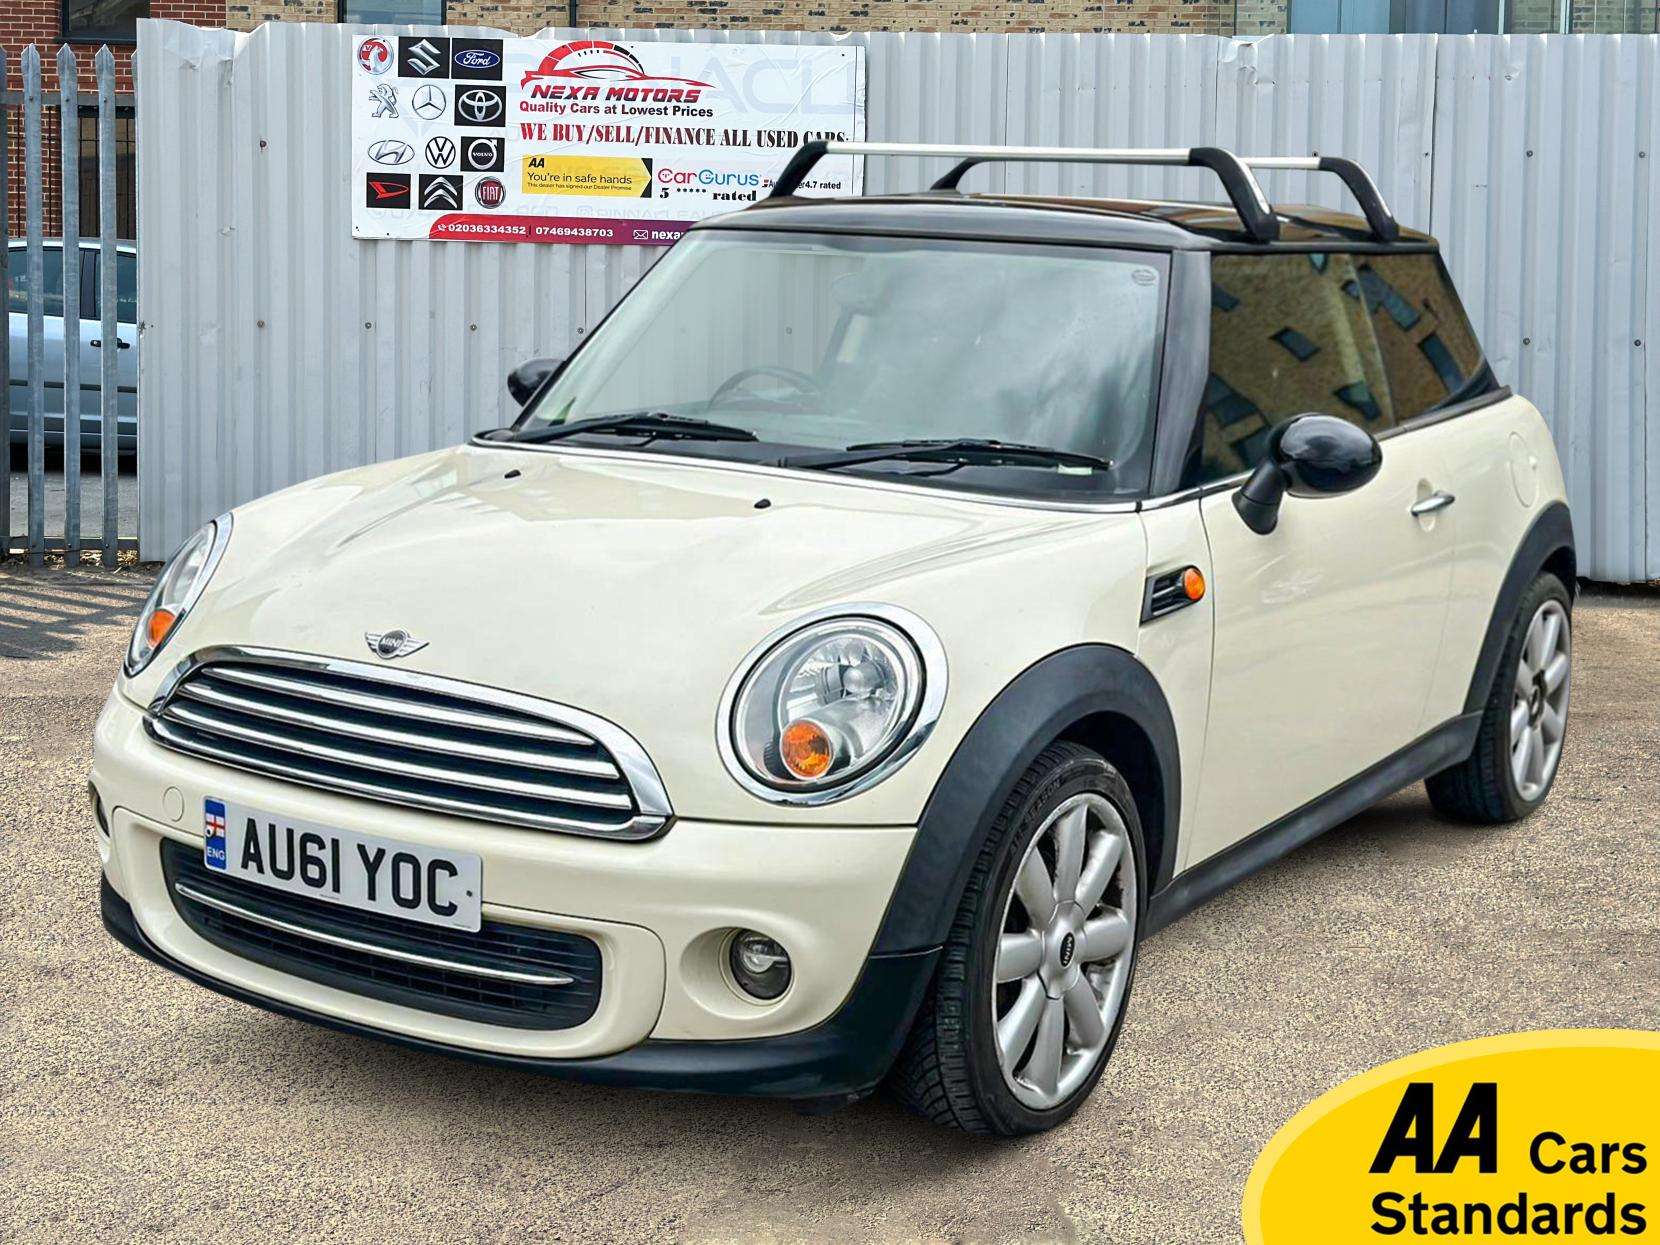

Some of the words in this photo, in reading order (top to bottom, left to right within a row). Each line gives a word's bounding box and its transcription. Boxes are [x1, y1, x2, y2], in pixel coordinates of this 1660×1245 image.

[463, 52, 491, 66] Ford
[531, 85, 600, 100] NEXA
[605, 87, 701, 103] MOTORS
[519, 101, 566, 115] Quality
[570, 103, 600, 114] Cars
[604, 105, 617, 115] at
[621, 104, 669, 116] Lowest
[672, 106, 714, 117] Prices
[520, 123, 547, 140] WE
[720, 129, 751, 146] ALL
[757, 130, 798, 148] USED
[528, 157, 545, 168] AA
[528, 172, 560, 182] You're
[563, 173, 572, 182] in
[575, 174, 597, 184] safe
[600, 175, 632, 184] hands
[658, 168, 760, 186] CarGurus
[819, 181, 841, 189] rated
[482, 186, 500, 201] FIAT
[660, 188, 670, 199] 5
[713, 190, 757, 201] rated
[448, 223, 527, 235] 02036334352
[536, 226, 613, 237] 07469438703
[652, 230, 684, 240] nexa
[206, 848, 226, 861] ENG
[241, 817, 341, 894] AU61
[357, 843, 458, 917] YOC
